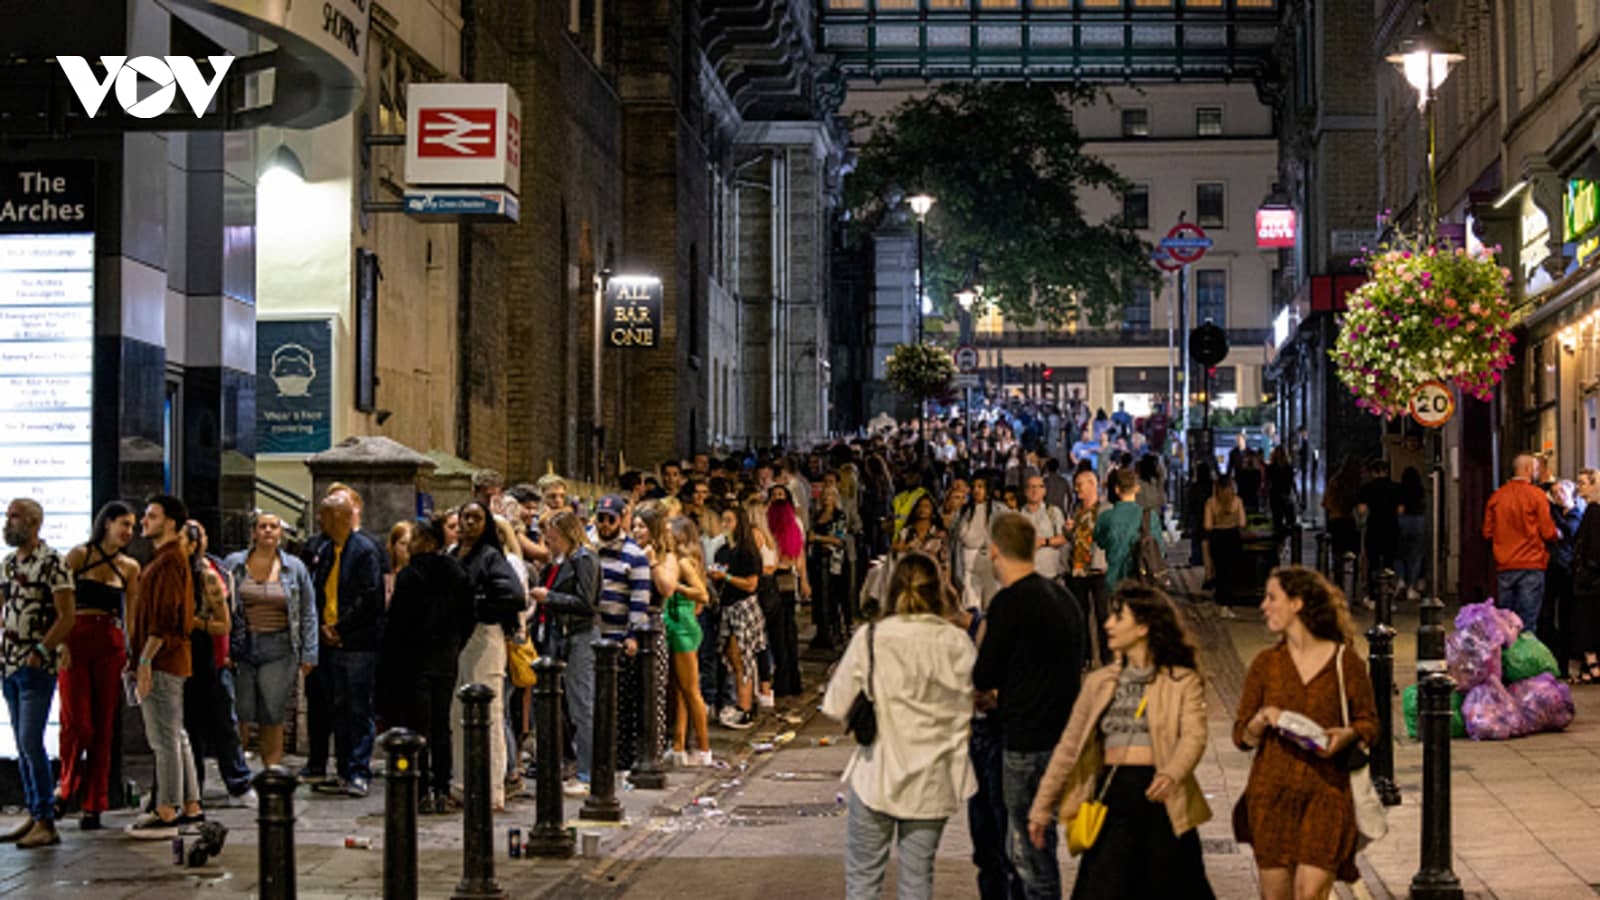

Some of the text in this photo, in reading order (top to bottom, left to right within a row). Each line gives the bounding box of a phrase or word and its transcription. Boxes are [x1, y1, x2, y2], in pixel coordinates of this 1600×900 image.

[18, 171, 67, 194] The
[0, 198, 86, 222] Arches
[616, 284, 651, 300] ALL
[614, 306, 651, 321] BAR
[611, 328, 653, 346] ONE
[1417, 390, 1448, 413] 20
